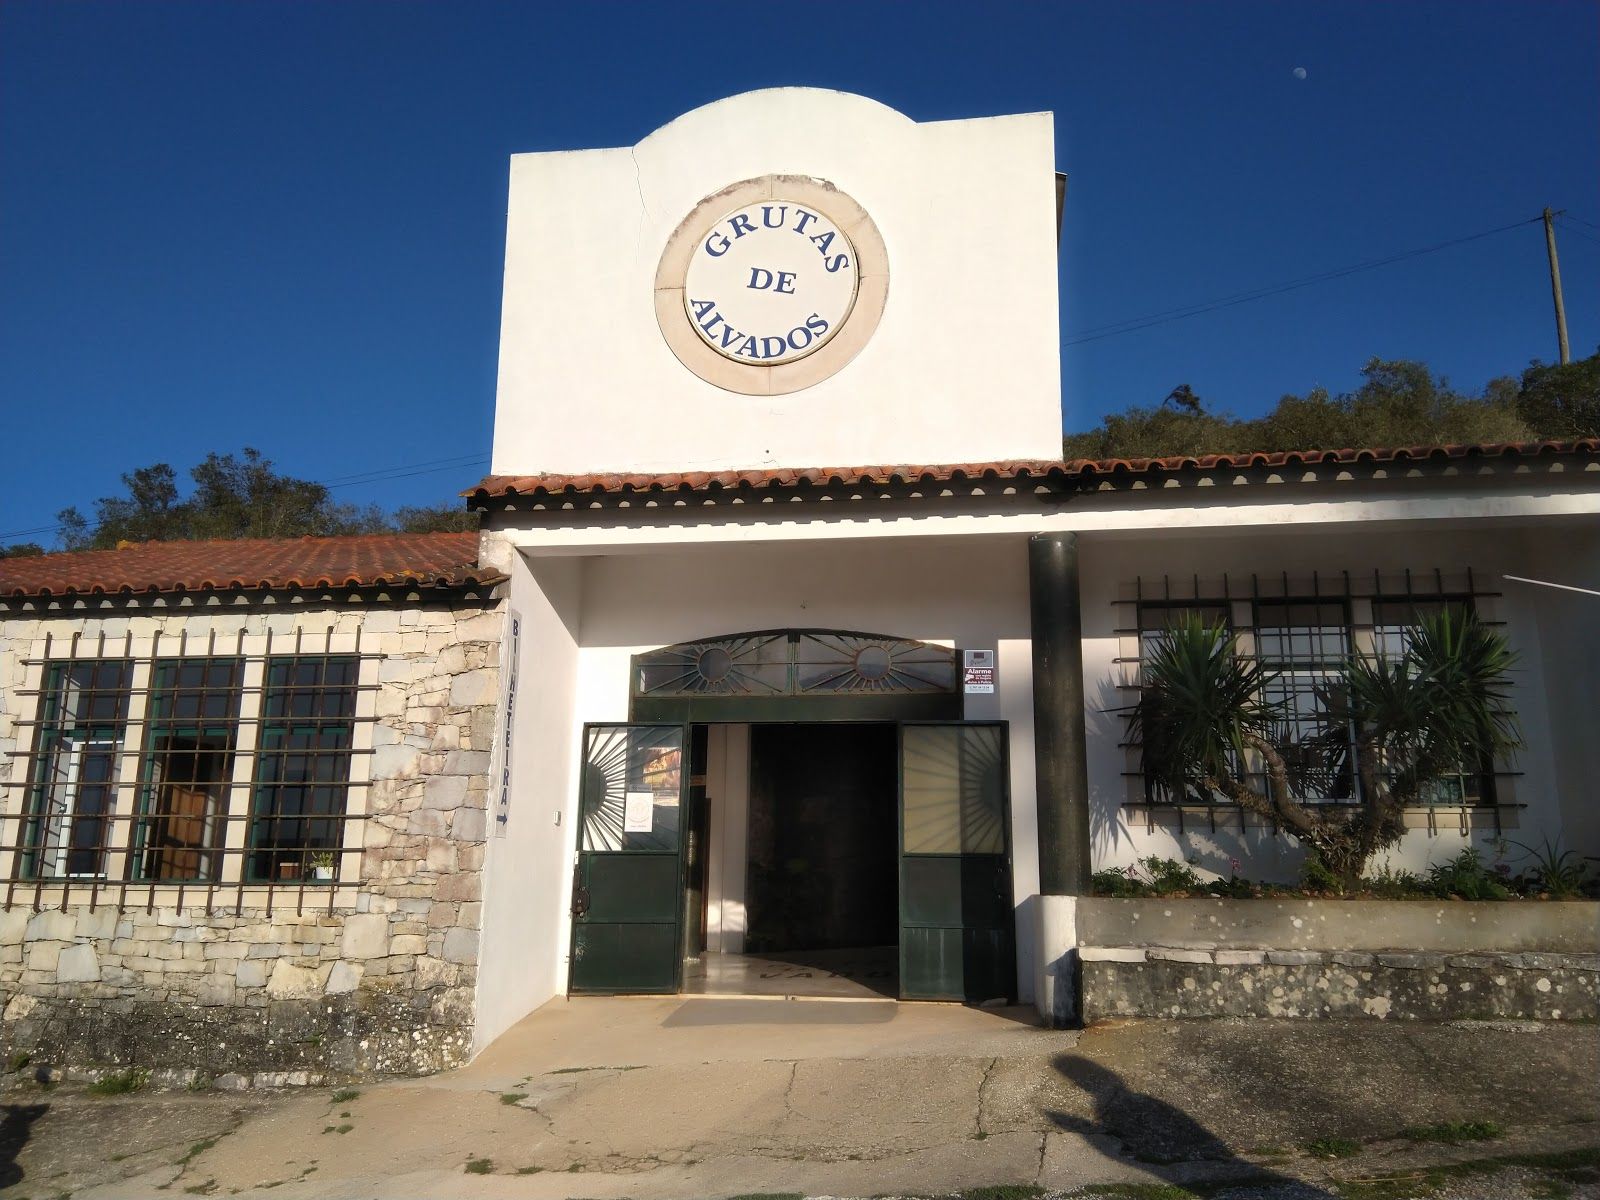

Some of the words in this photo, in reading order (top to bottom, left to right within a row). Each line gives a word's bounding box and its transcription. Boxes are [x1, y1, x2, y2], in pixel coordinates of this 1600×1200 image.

[705, 206, 849, 274] GRUTAS
[747, 267, 797, 295] DE
[690, 298, 830, 360] ALVADOS
[500, 618, 519, 806] BILHETEIRA
